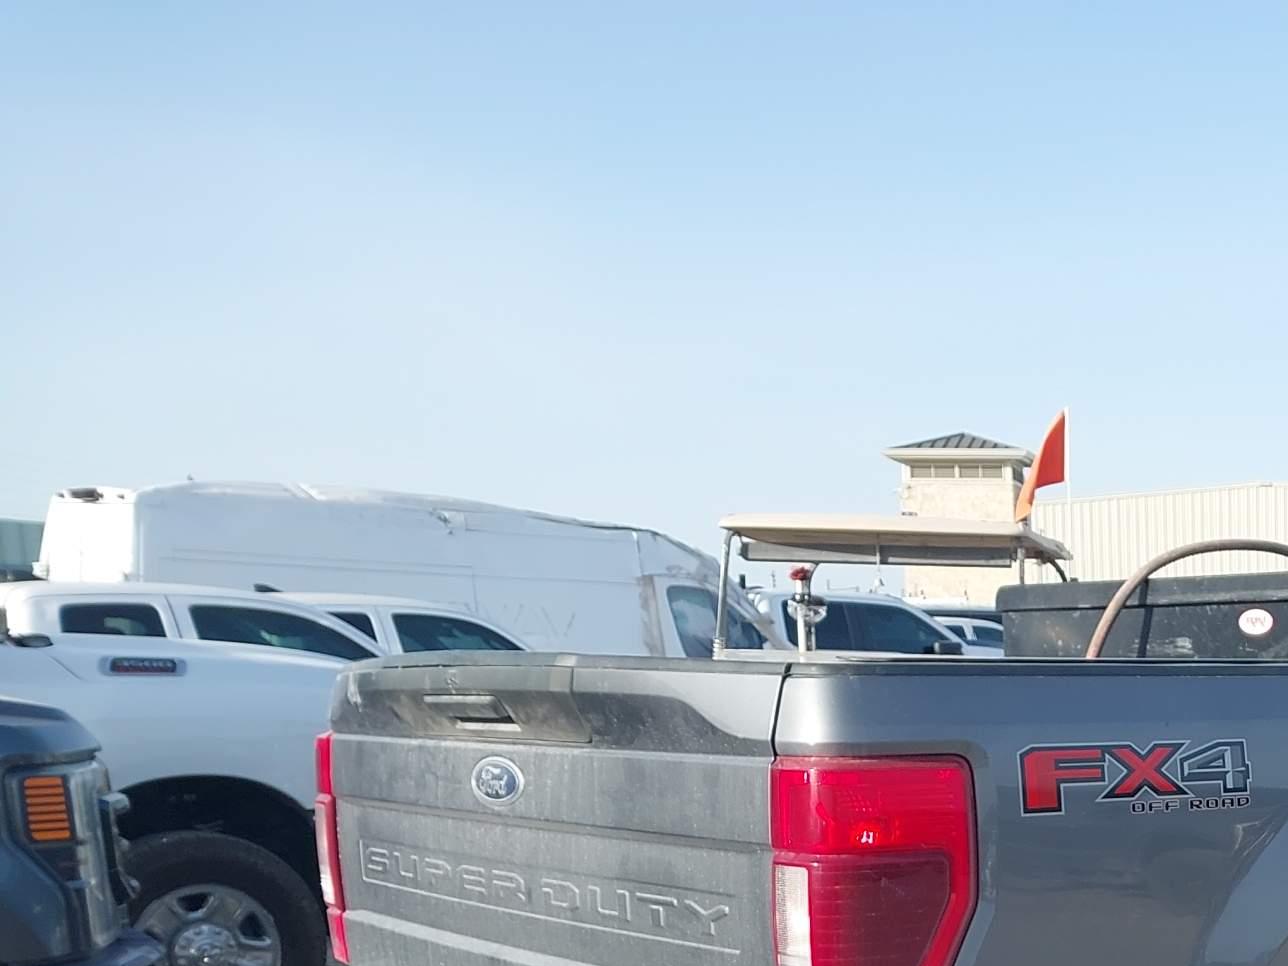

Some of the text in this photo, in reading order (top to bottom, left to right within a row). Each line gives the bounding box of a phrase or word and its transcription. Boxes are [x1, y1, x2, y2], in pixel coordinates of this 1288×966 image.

[1017, 739, 1252, 816] FX4
[1131, 796, 1251, 814] OFF ROAD
[365, 847, 730, 937] SUPER DUTY
